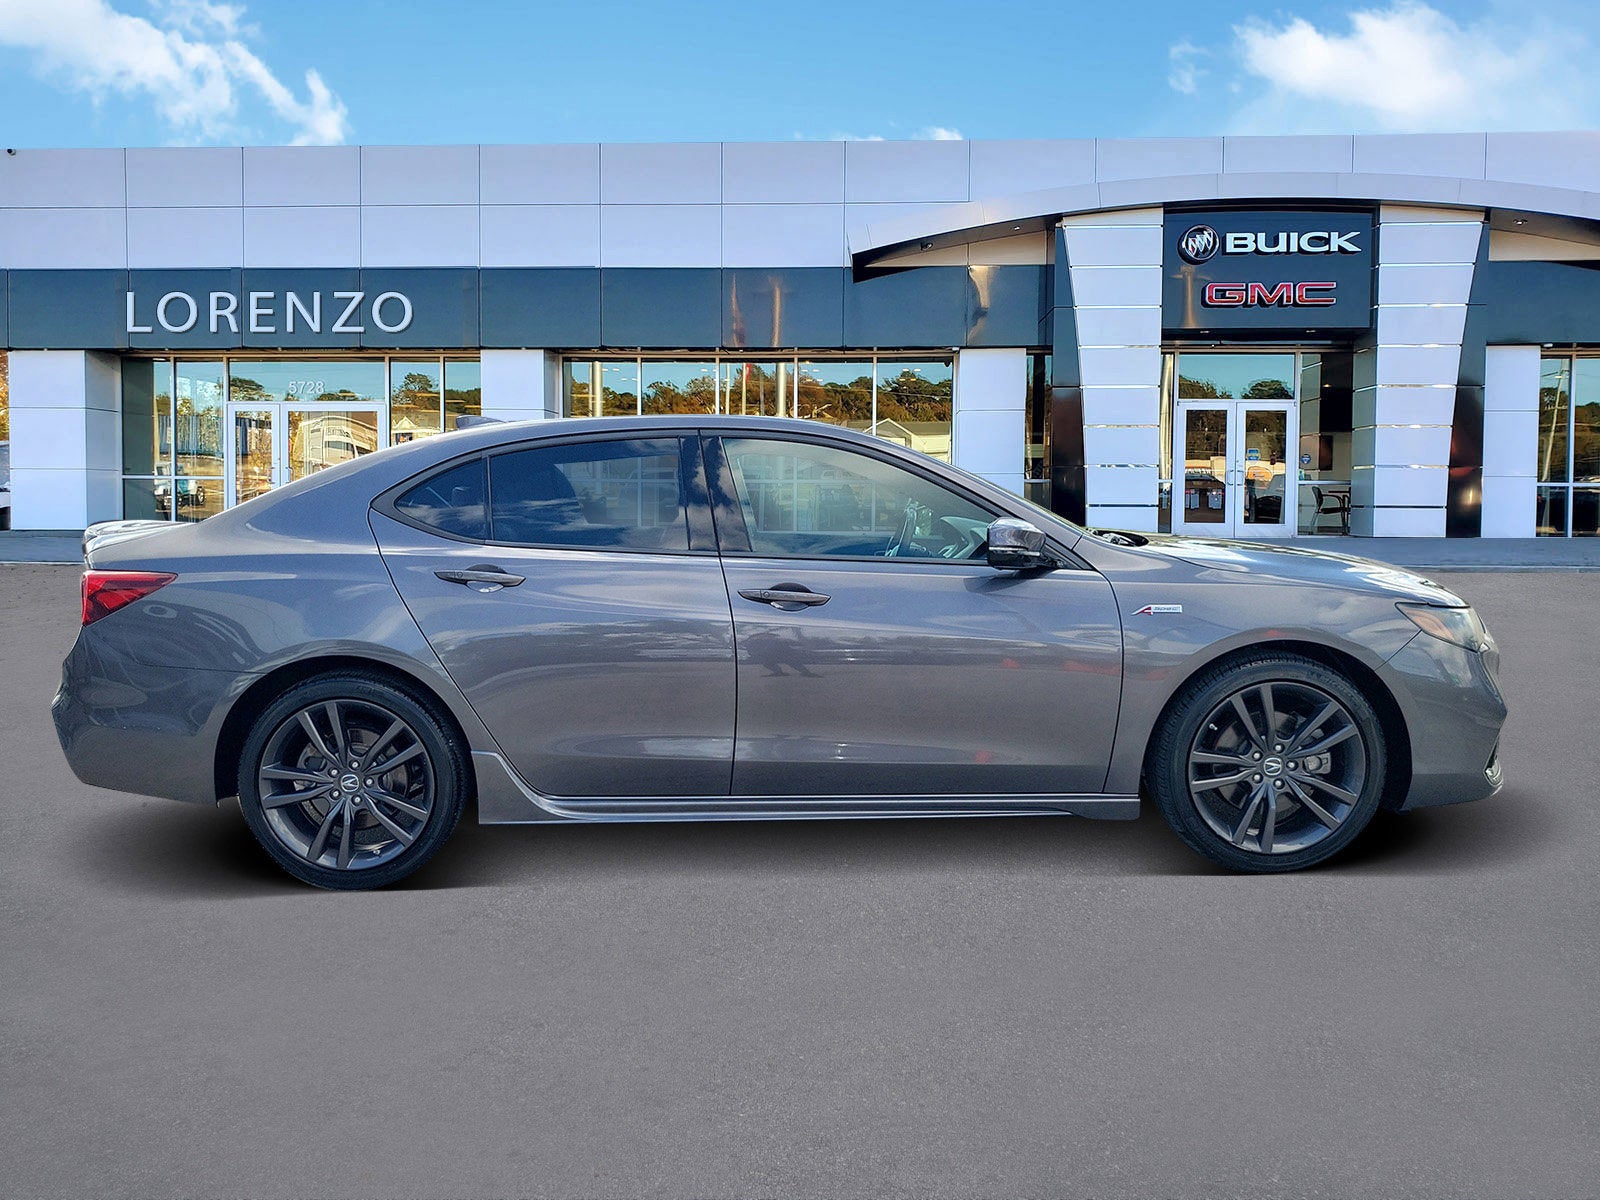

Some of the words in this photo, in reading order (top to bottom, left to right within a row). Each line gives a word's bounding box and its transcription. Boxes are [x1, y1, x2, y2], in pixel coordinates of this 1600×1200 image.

[1225, 231, 1361, 253] BUICK
[1206, 282, 1336, 305] GMC
[126, 291, 413, 333] LORENZO
[288, 380, 325, 394] 5728
